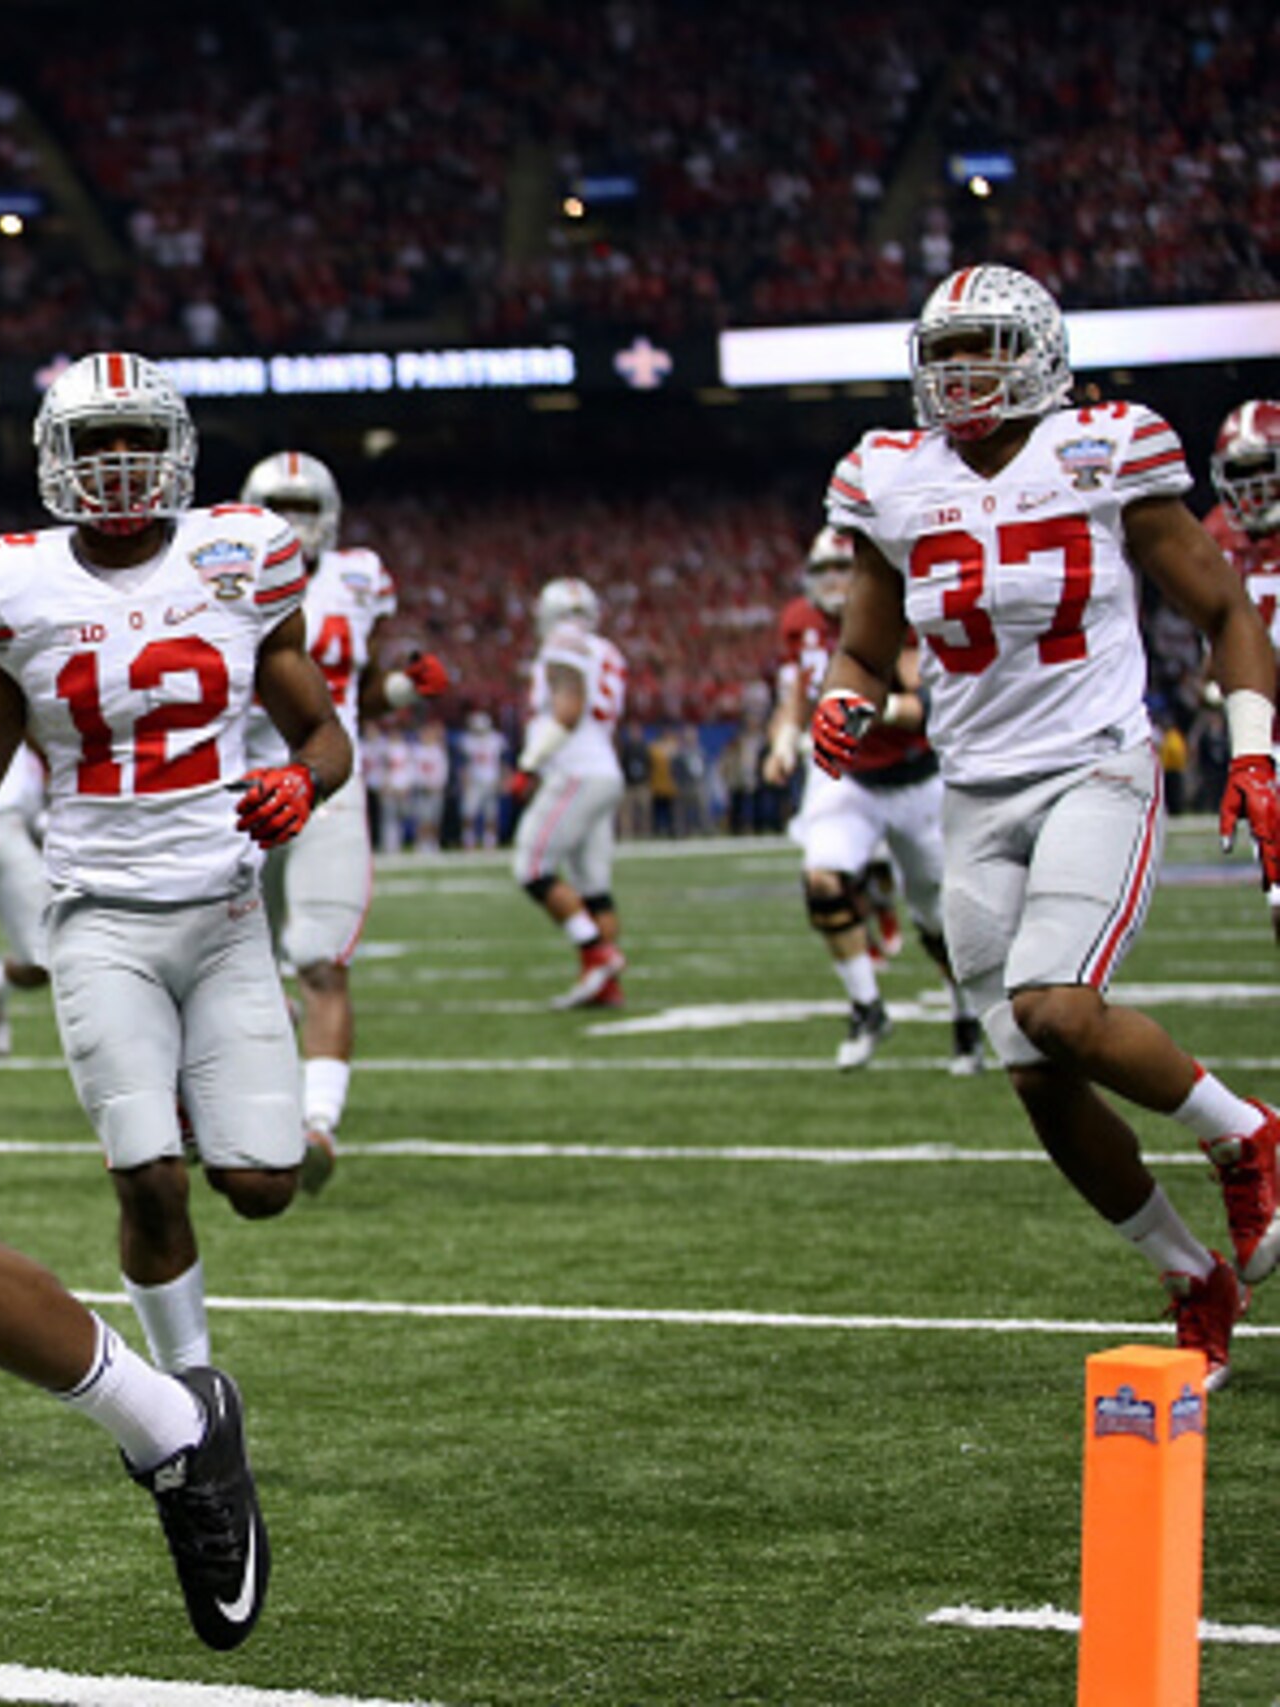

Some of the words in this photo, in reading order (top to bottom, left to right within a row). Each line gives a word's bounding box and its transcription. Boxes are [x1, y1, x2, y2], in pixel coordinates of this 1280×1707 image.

[394, 345, 576, 391] PARTNERS
[909, 514, 1093, 676] 37
[56, 635, 230, 795] 12
